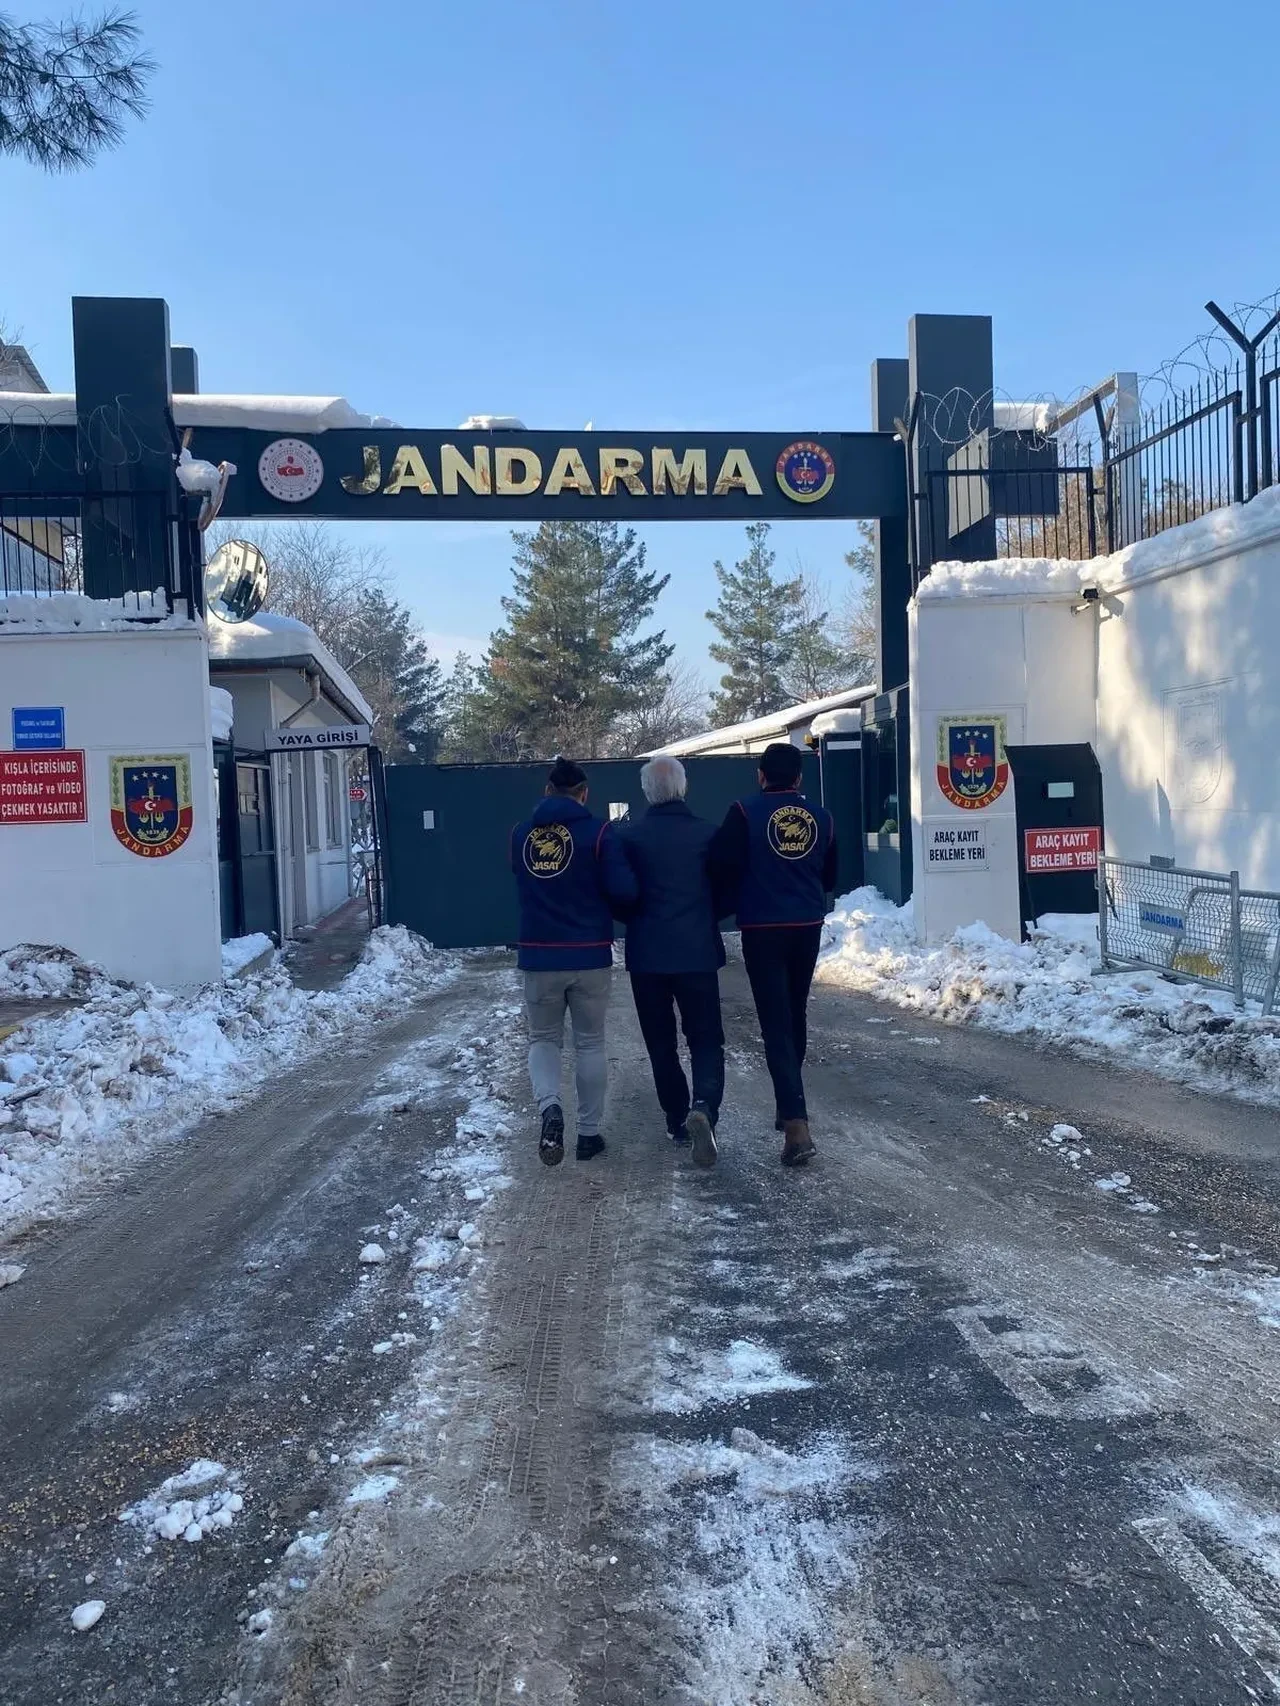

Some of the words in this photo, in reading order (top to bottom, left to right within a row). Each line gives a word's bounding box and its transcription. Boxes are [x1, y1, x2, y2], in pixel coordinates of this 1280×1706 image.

[339, 444, 764, 496] JANDARMA
[278, 735, 313, 745] YAYA
[316, 729, 359, 744] GİRİŞİ
[4, 761, 29, 776] KIŞLA
[30, 759, 77, 775] İÇERİSİNDE
[1, 780, 43, 796] FOTOĞRAF
[46, 784, 55, 794] ve
[57, 779, 81, 794] VİDEO
[942, 781, 1006, 808] JANDARMA
[1, 802, 36, 818] ÇEKMEK
[37, 801, 78, 815] YASAKTIR
[772, 807, 813, 824] JANDARMA
[116, 826, 189, 856] JANDARMA
[779, 842, 806, 851] JASAT
[934, 831, 955, 846] ARAÇ
[957, 831, 979, 843] KAYIT
[1035, 834, 1061, 850] ARAÇ
[1062, 833, 1089, 847] KAYIT
[929, 848, 965, 862] BEKLEME
[967, 845, 985, 860] YERİ
[1030, 852, 1073, 868] BEKLEME
[1074, 848, 1096, 865] YERİ
[532, 861, 560, 870] JASAT
[1142, 911, 1184, 930] JANDARMA
